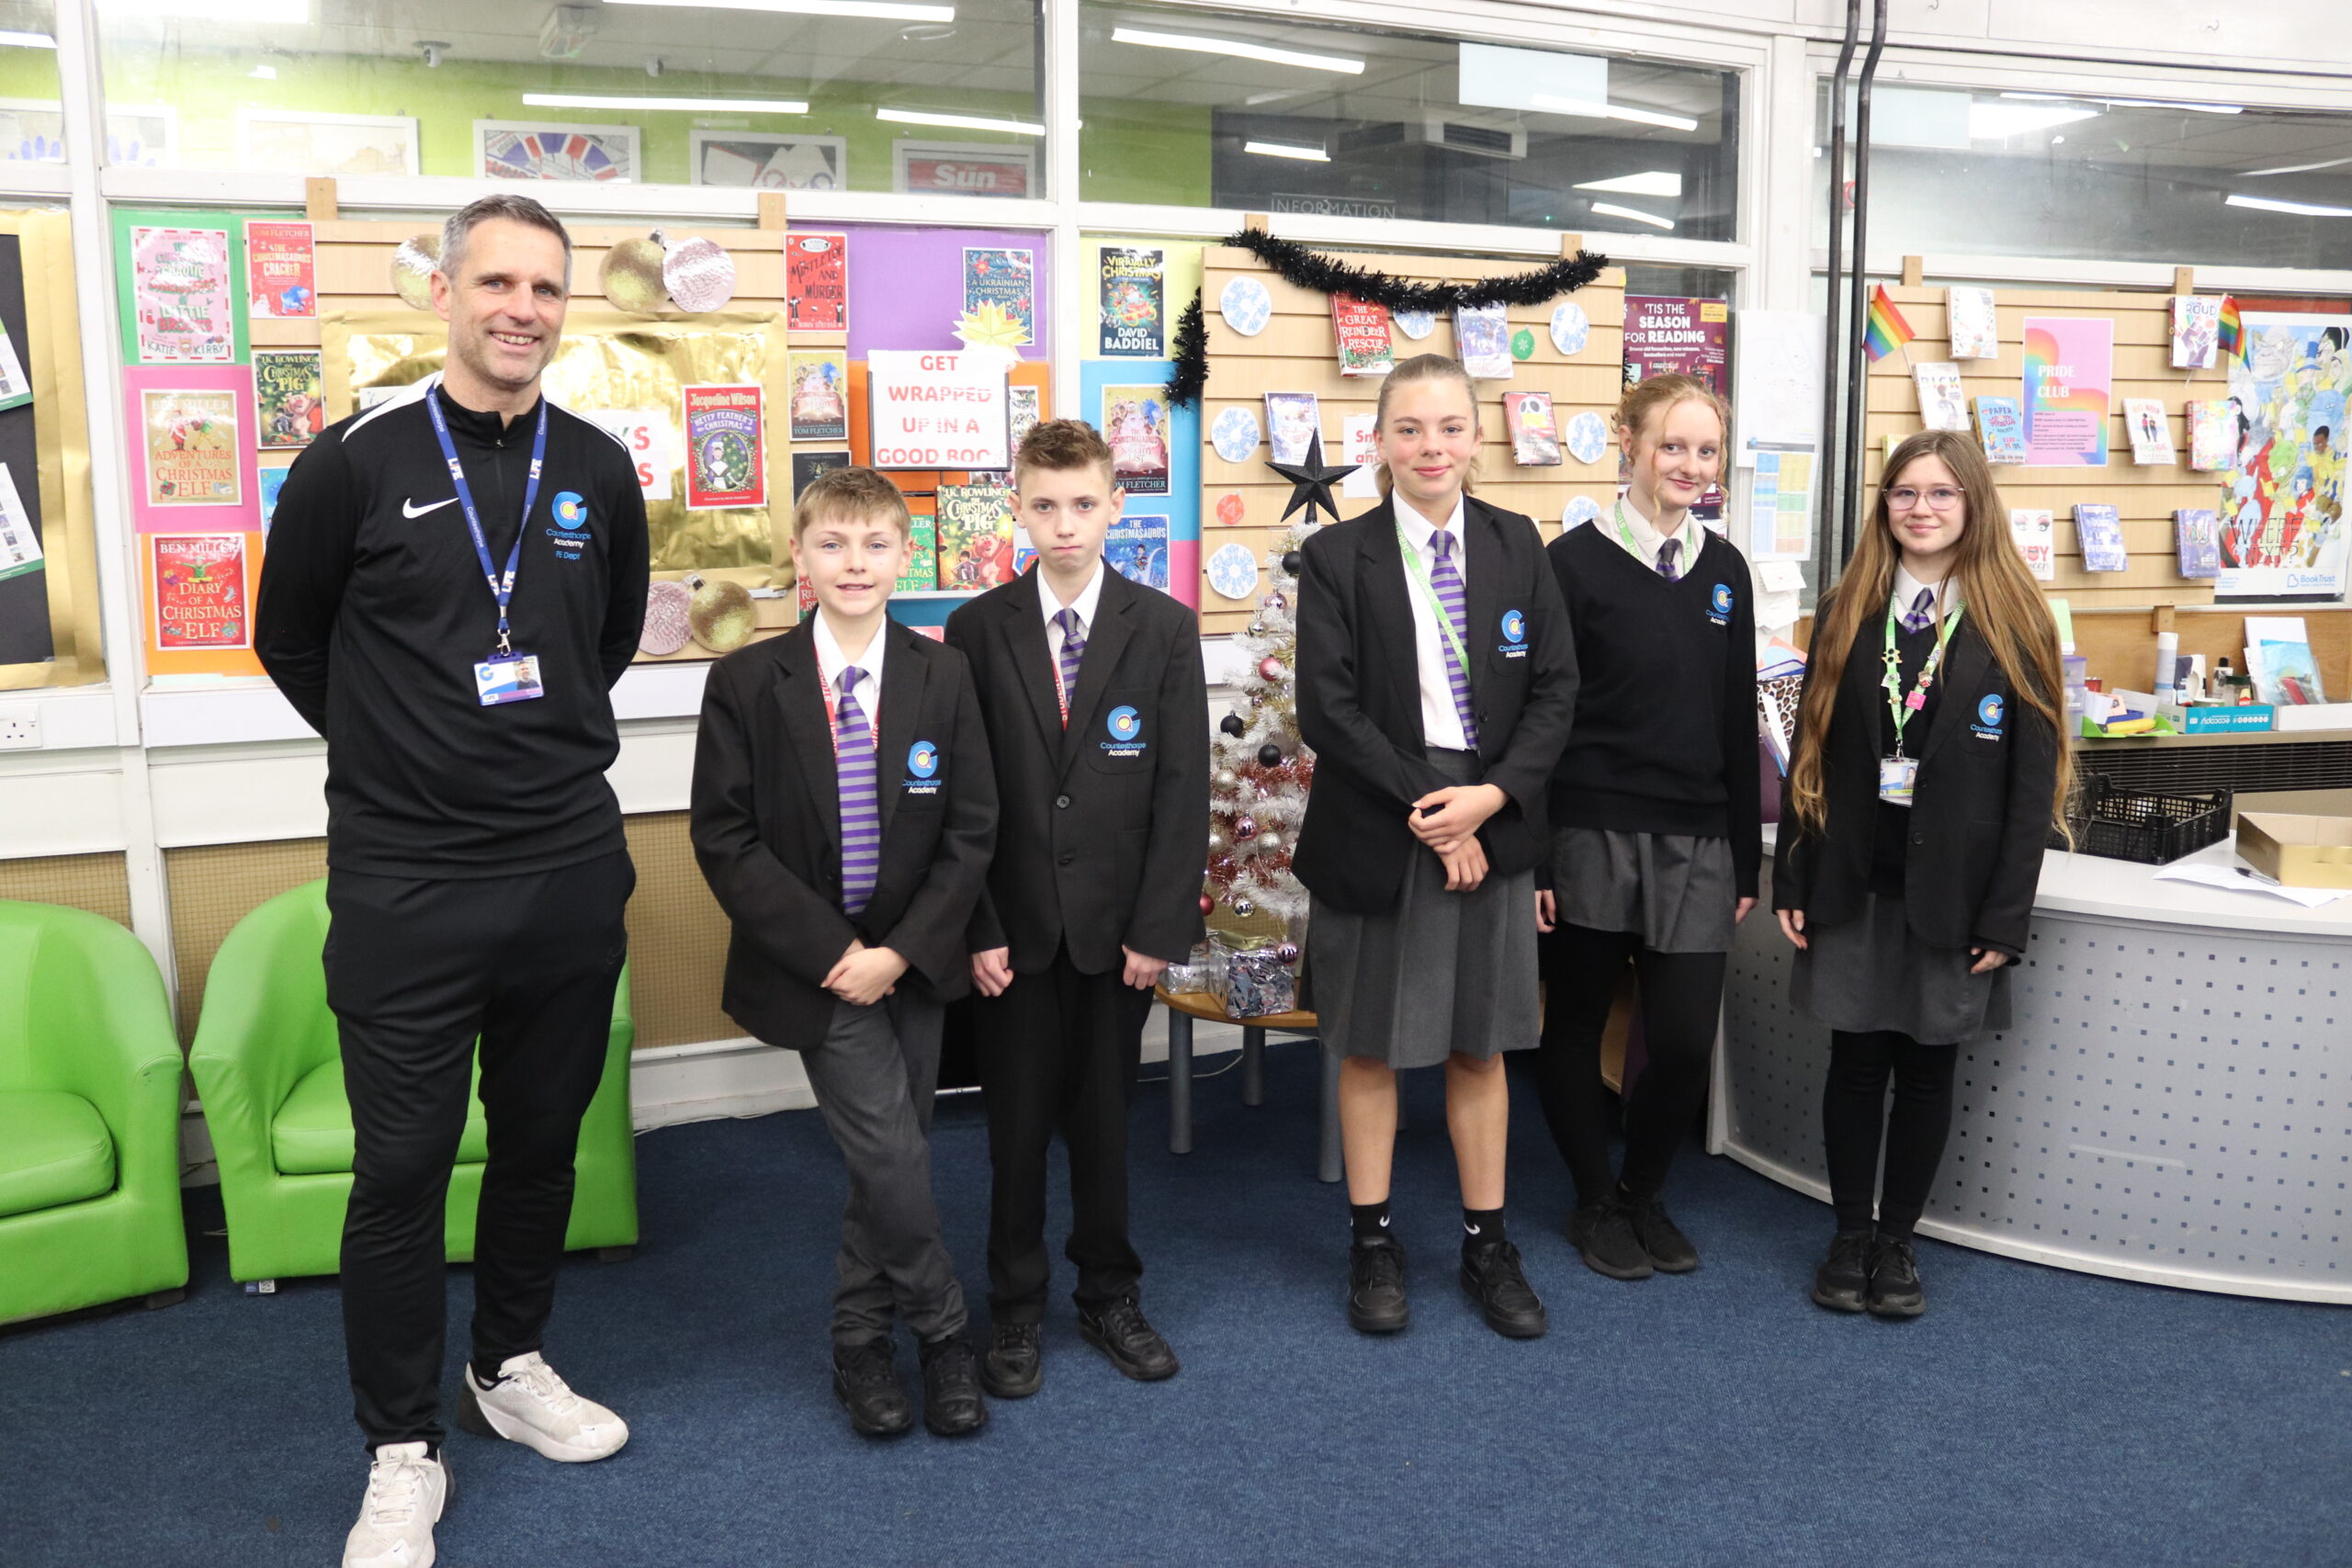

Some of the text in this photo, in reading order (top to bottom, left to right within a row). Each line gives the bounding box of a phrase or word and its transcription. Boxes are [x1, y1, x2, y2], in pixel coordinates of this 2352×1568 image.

[933, 164, 996, 187] Sun
[1271, 198, 1396, 219] INFORMATION
[1106, 256, 1156, 267] VIRTUALLY
[979, 277, 1024, 287] UKRAINIAN
[805, 284, 843, 299] MURDER
[1645, 304, 1685, 314] 'TIS THE
[1345, 315, 1378, 324] GREAT
[1639, 316, 1690, 329] SEASON
[1118, 328, 1148, 337] DAVID
[1341, 326, 1386, 338] REINDEER
[1625, 331, 1705, 343] FOR READING
[147, 341, 225, 355] KATIE KIRBY
[1105, 337, 1159, 350] BADDIEL
[1348, 339, 1385, 349] RESCUE
[276, 355, 314, 363] ROWLING
[921, 355, 958, 371] GET
[264, 366, 311, 382] CHRISTMAS
[2038, 365, 2075, 378] PRIDE
[277, 378, 304, 391] PIG
[888, 386, 991, 402] WRAPPED
[2037, 386, 2069, 398] CLUB
[690, 393, 756, 410] Jacqueline Wilson
[428, 393, 445, 433] Countesthorpe
[1988, 407, 2012, 415] PAPER
[694, 412, 753, 426] HETTY FEATHER'S
[705, 420, 743, 431] CHRISTMAS
[902, 417, 980, 434] UP IN A
[155, 450, 232, 460] ADVENTURES
[876, 447, 939, 465] GOOD
[156, 468, 232, 481] CHRISTMAS
[447, 457, 464, 480] LIFE
[529, 458, 543, 479] LIFE
[178, 481, 210, 497] ELF
[944, 488, 1005, 497] J.K. ROWLING
[946, 499, 1003, 521] CHRISTMAS
[467, 506, 484, 548] Countesthorpe
[961, 513, 996, 531] PIG
[1129, 520, 1142, 528] THE
[546, 528, 593, 540] Countesthorpe
[1106, 527, 1166, 539] CHRISTMASAURUS
[2230, 517, 2303, 545] WHERE
[160, 542, 240, 554] BEN MILLER
[553, 537, 584, 549] Academy
[2245, 545, 2299, 565] NEXT?
[501, 570, 515, 592] LIFE
[2300, 575, 2335, 583] BookTrust
[179, 582, 222, 595] DIARY
[188, 596, 203, 605] OF
[163, 605, 242, 619] CHRISTMAS
[185, 623, 220, 639] ELF
[1442, 620, 1464, 658] STUDENT
[1100, 741, 1147, 750] Countesthorpe
[1108, 749, 1140, 757] Academy
[908, 786, 937, 795] Academy
